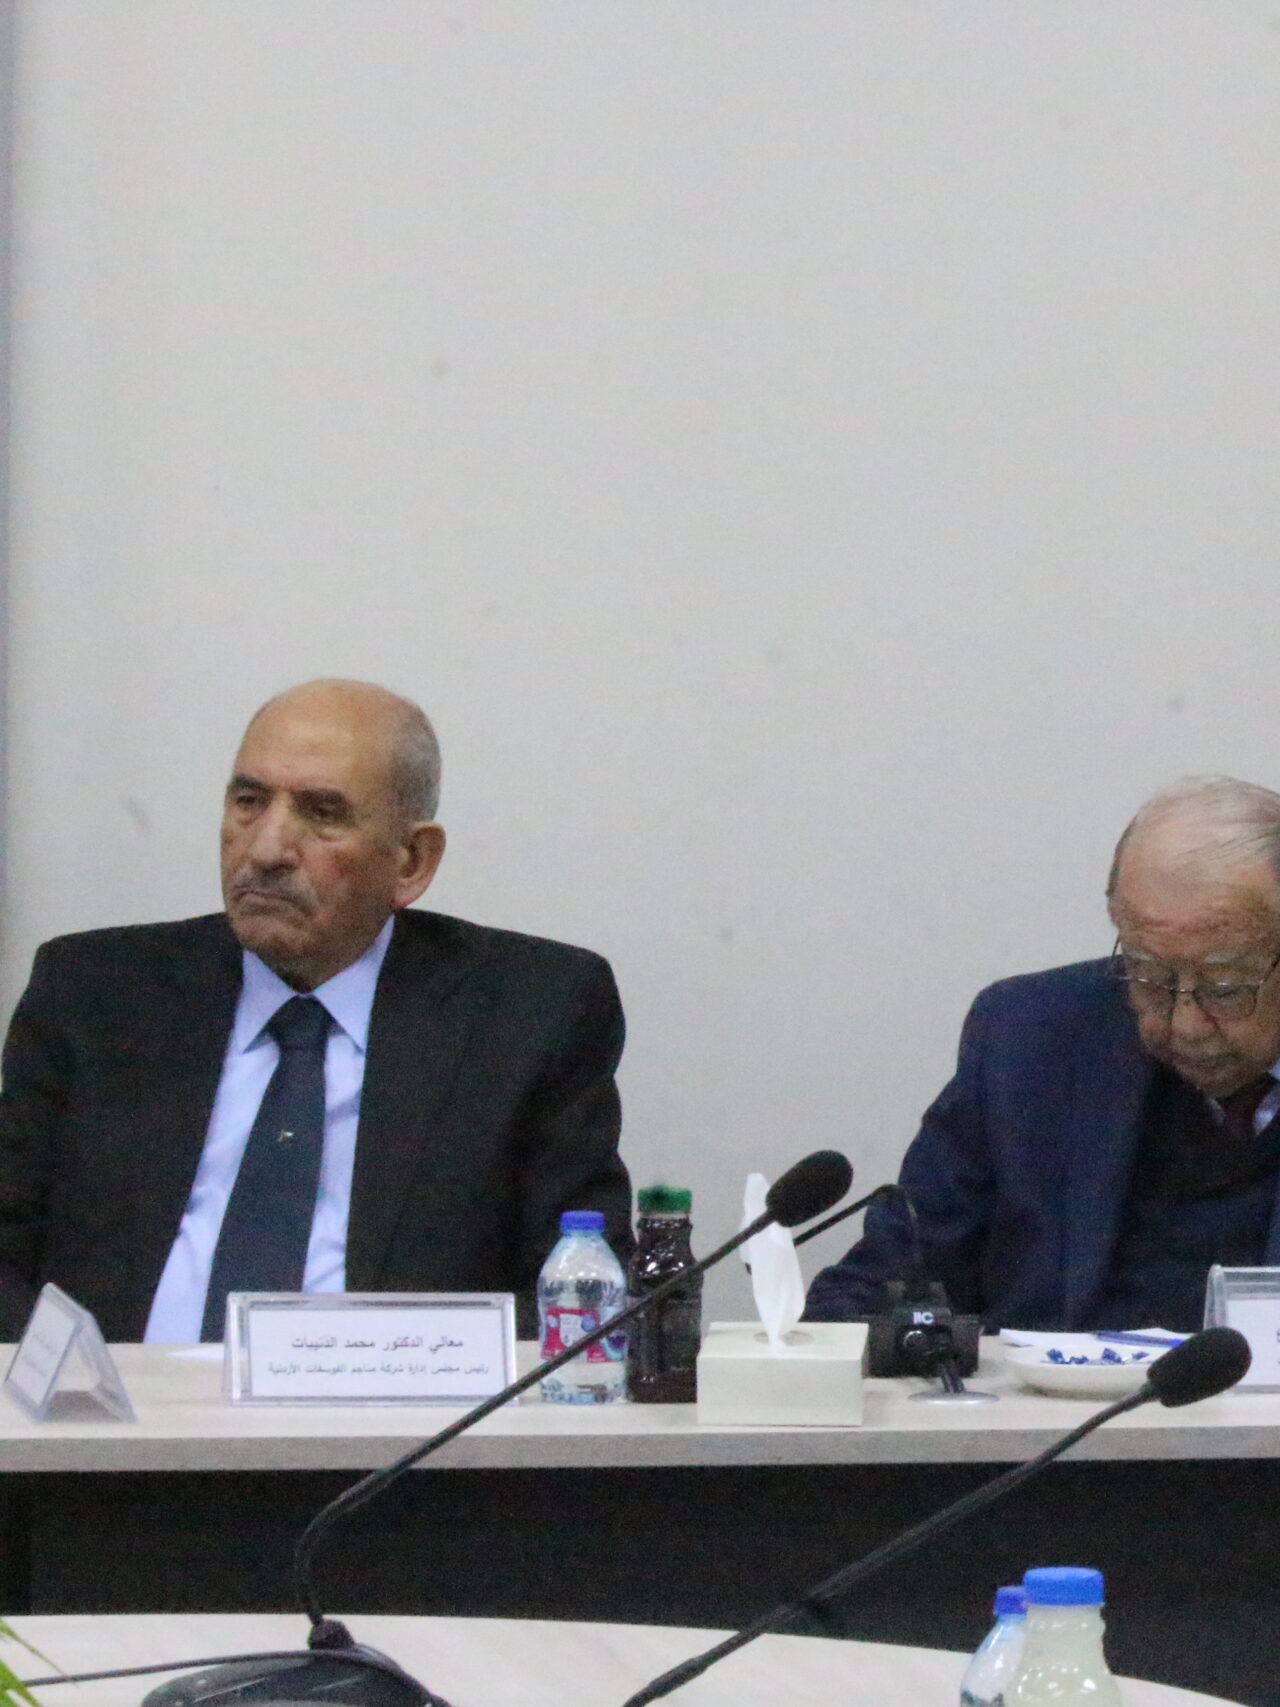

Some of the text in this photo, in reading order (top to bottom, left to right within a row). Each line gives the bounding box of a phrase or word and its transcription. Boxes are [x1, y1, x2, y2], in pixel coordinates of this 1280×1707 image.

[343, 1337, 376, 1349] محمد
[382, 1336, 424, 1351] الدكتور
[429, 1336, 464, 1354] معالي
